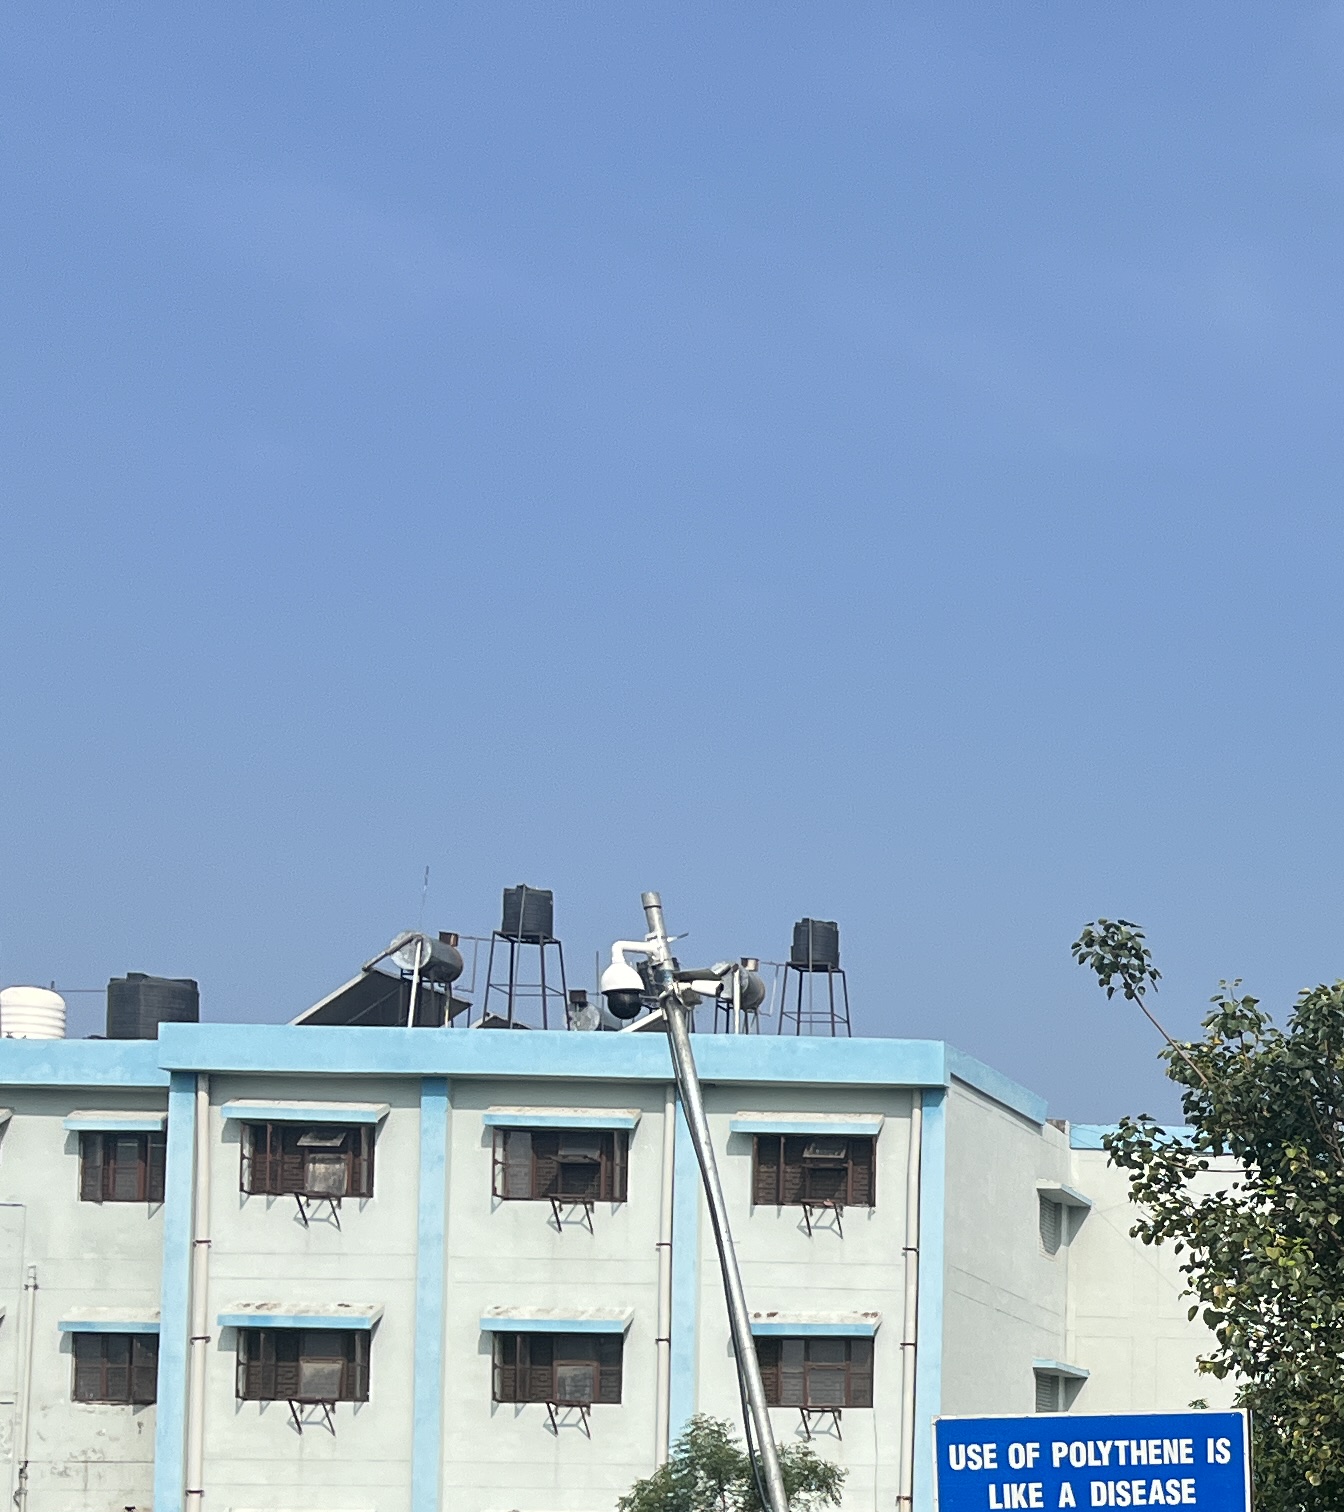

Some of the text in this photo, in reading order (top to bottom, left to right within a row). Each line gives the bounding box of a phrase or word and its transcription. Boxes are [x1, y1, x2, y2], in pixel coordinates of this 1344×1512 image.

[949, 1438, 1230, 1470] USE OF POLYTHENE IS
[989, 1479, 1196, 1509] LIKE A DISEASE
